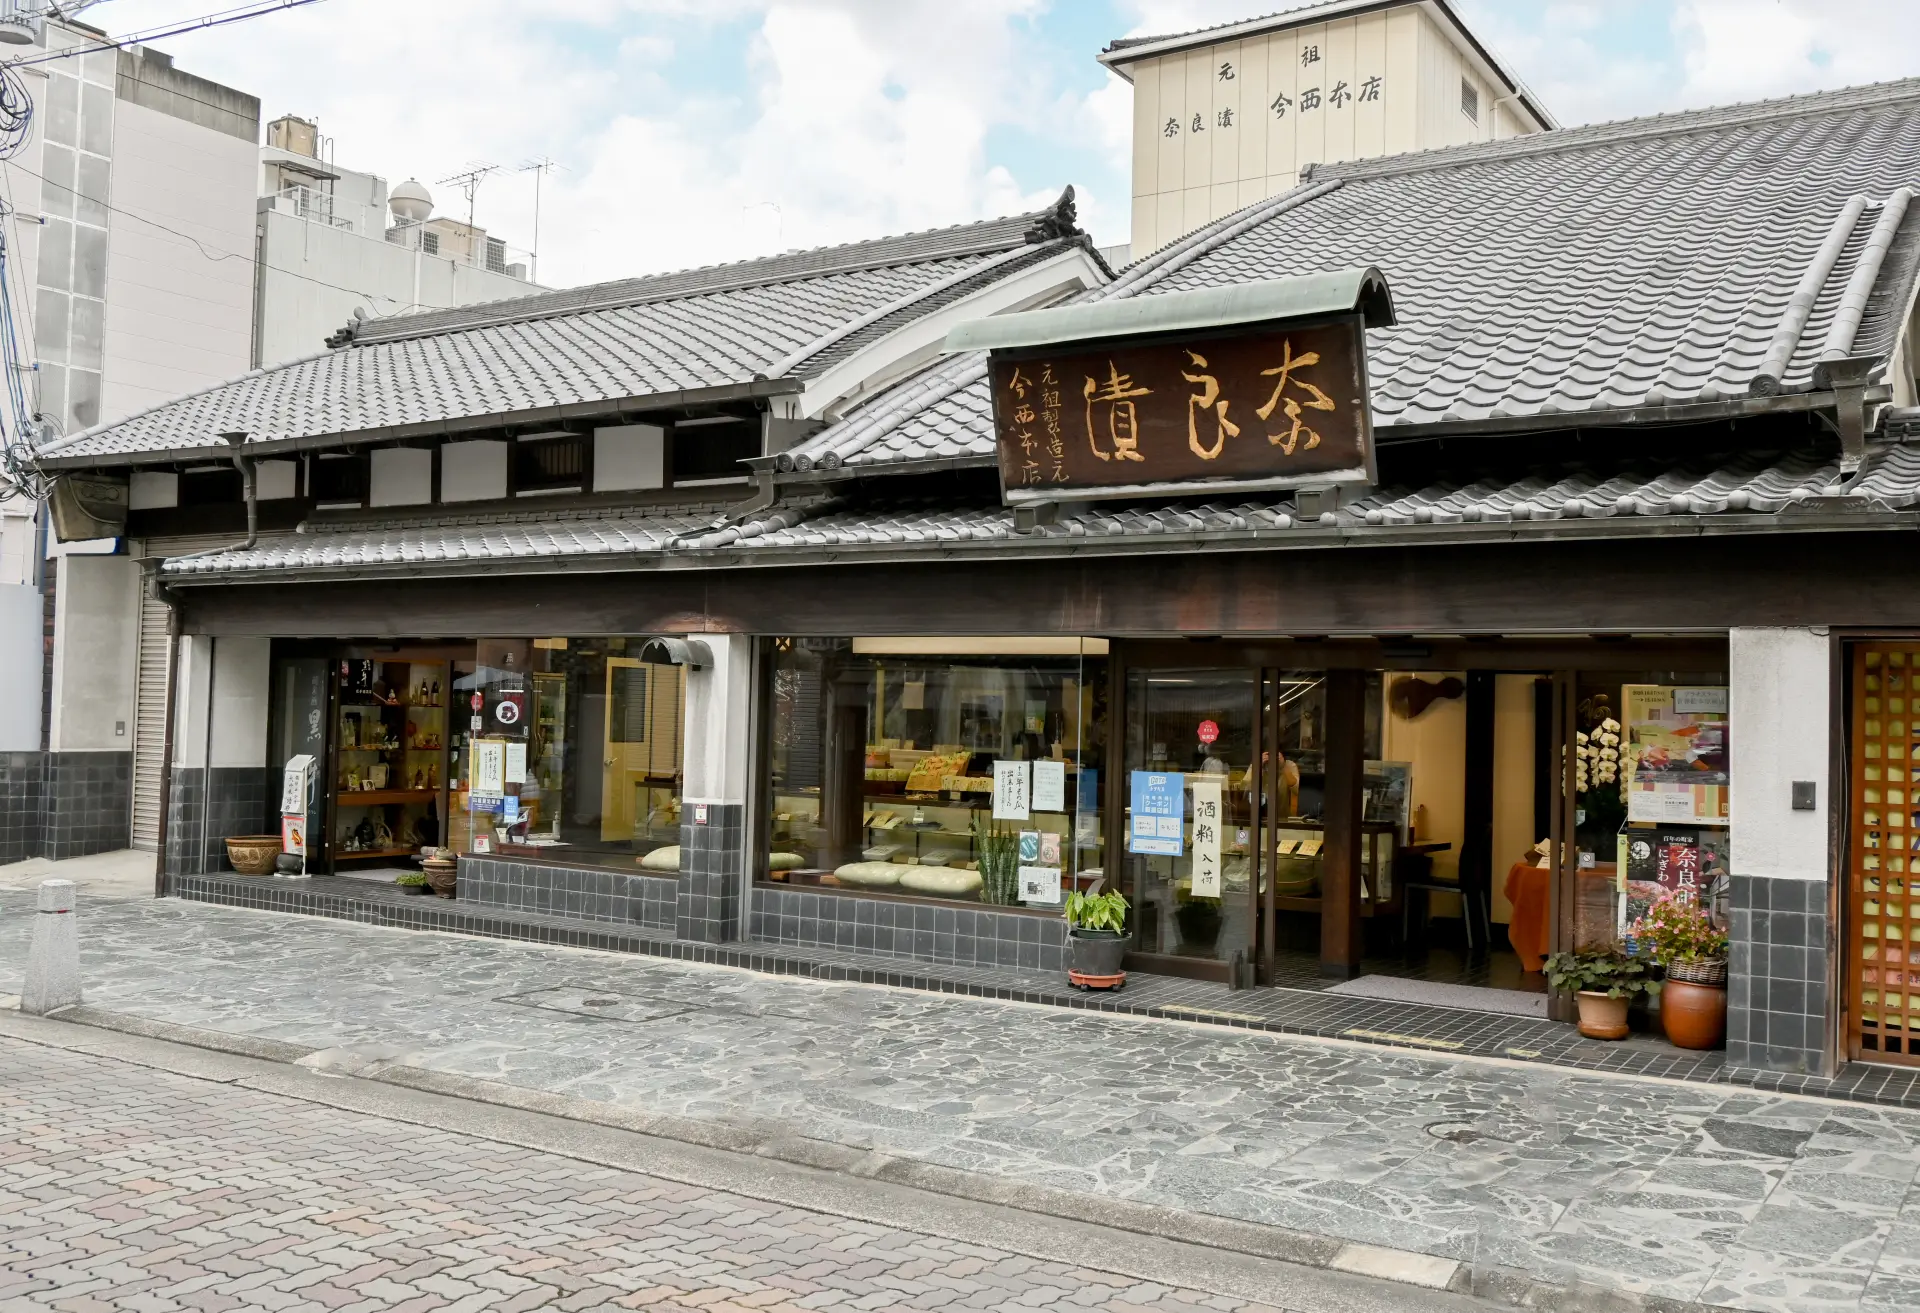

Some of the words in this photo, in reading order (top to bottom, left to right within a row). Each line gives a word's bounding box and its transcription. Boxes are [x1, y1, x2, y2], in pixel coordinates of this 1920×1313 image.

[1164, 107, 1233, 138] 奈良漬
[1271, 76, 1382, 119] 今西本店
[1010, 368, 1042, 485] 今西本店
[1084, 338, 1335, 462] 奈良漬
[1196, 800, 1216, 885] 酒粕入荷
[1663, 835, 1694, 843] 百年の町家
